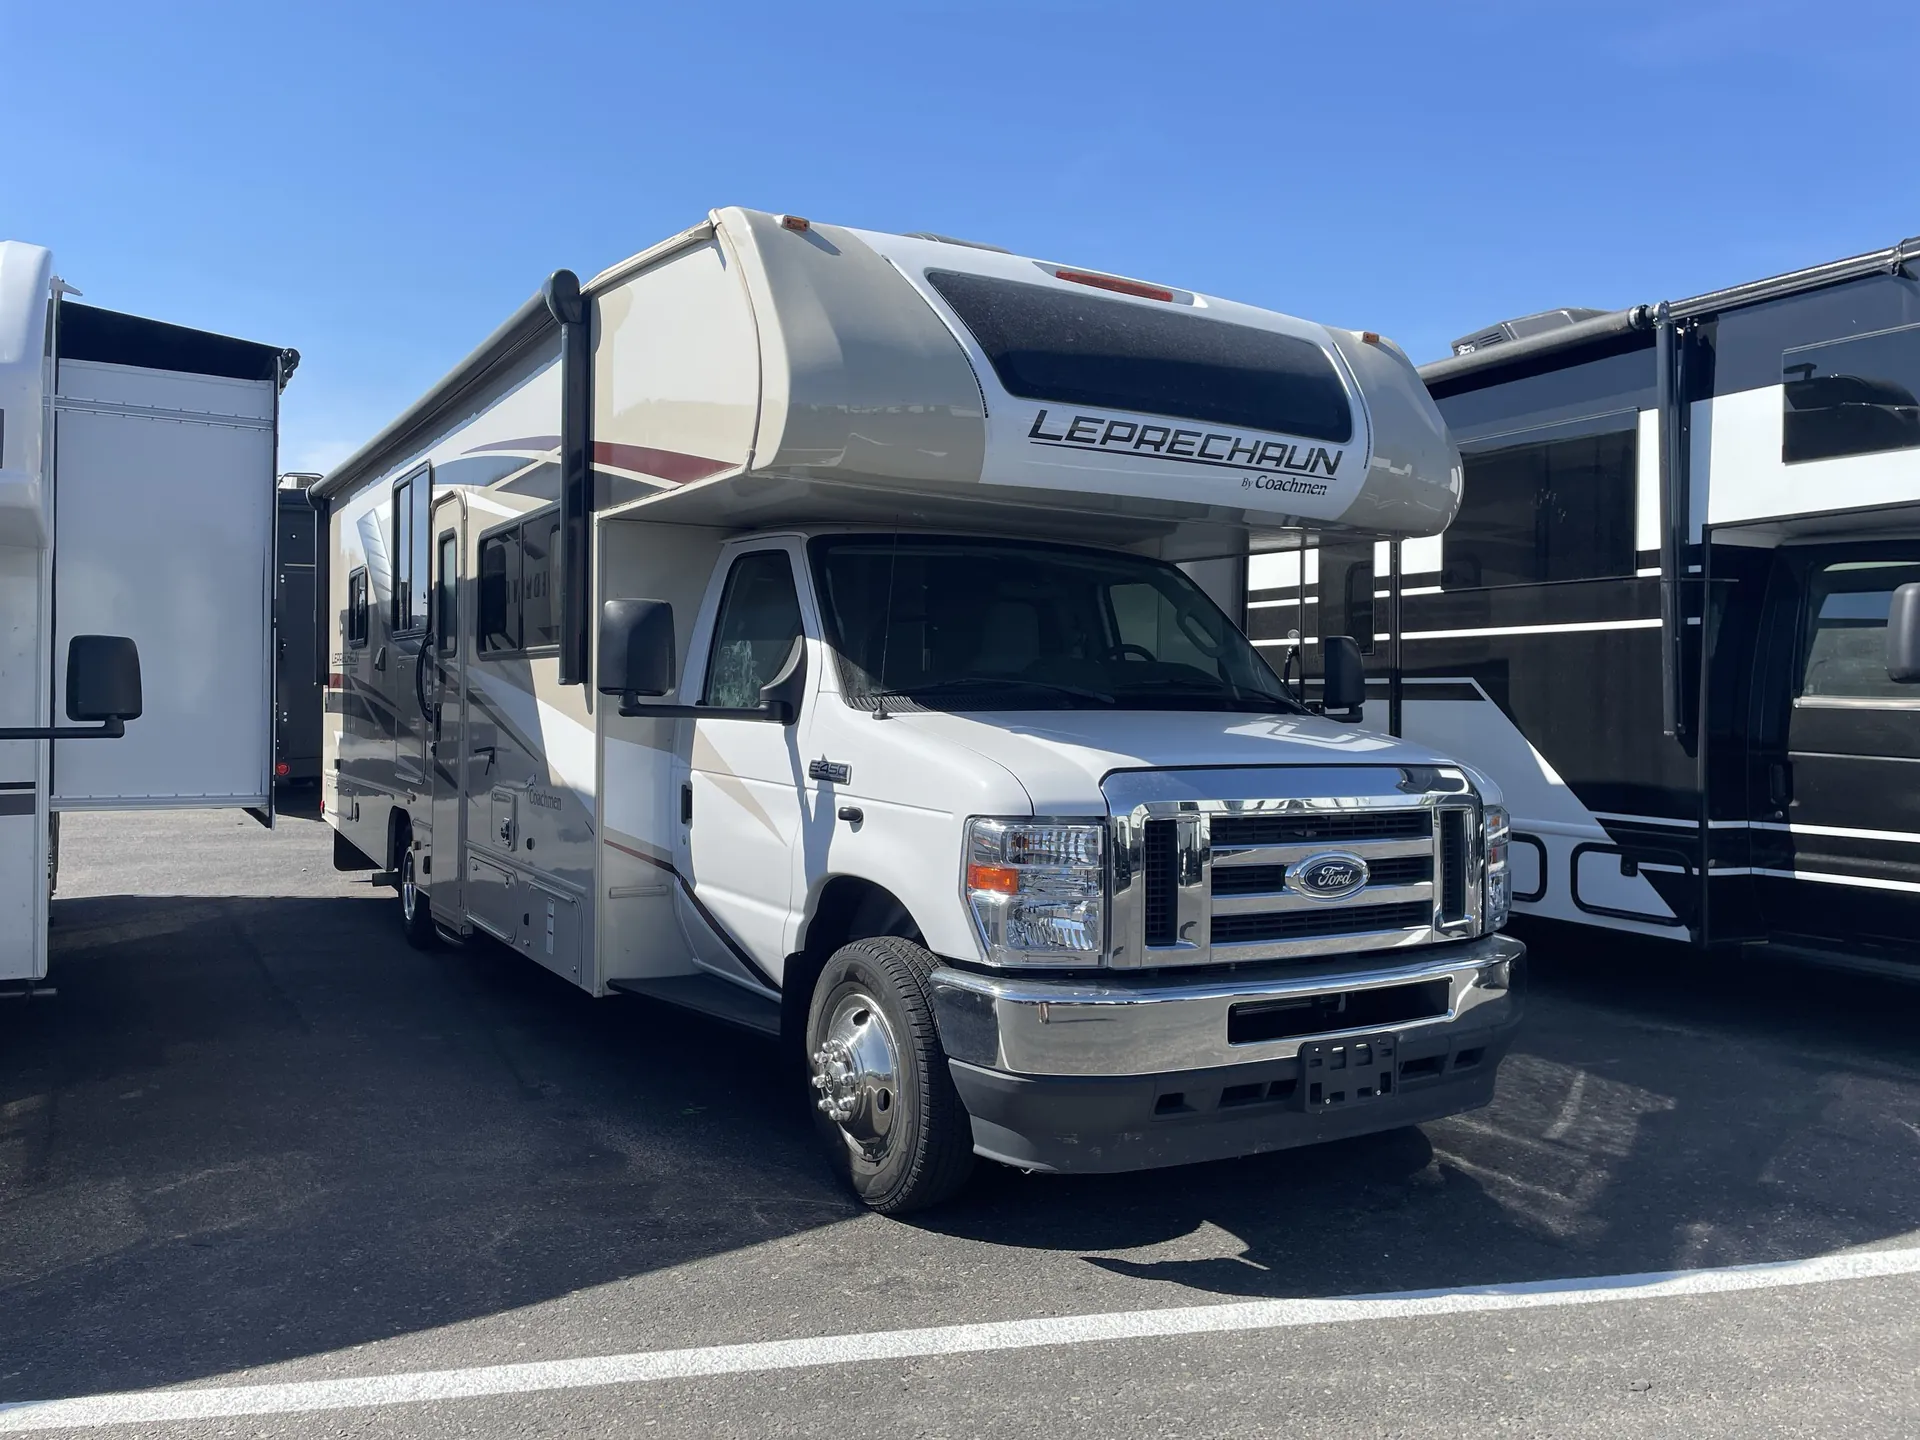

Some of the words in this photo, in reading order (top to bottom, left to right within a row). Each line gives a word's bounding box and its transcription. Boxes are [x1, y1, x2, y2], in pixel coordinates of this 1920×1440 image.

[1028, 409, 1343, 475] LEPRECHAUN
[1241, 477, 1254, 490] By
[1255, 475, 1328, 496] Coachmen
[529, 787, 562, 811] Coachmen
[1317, 866, 1353, 886] Ford
